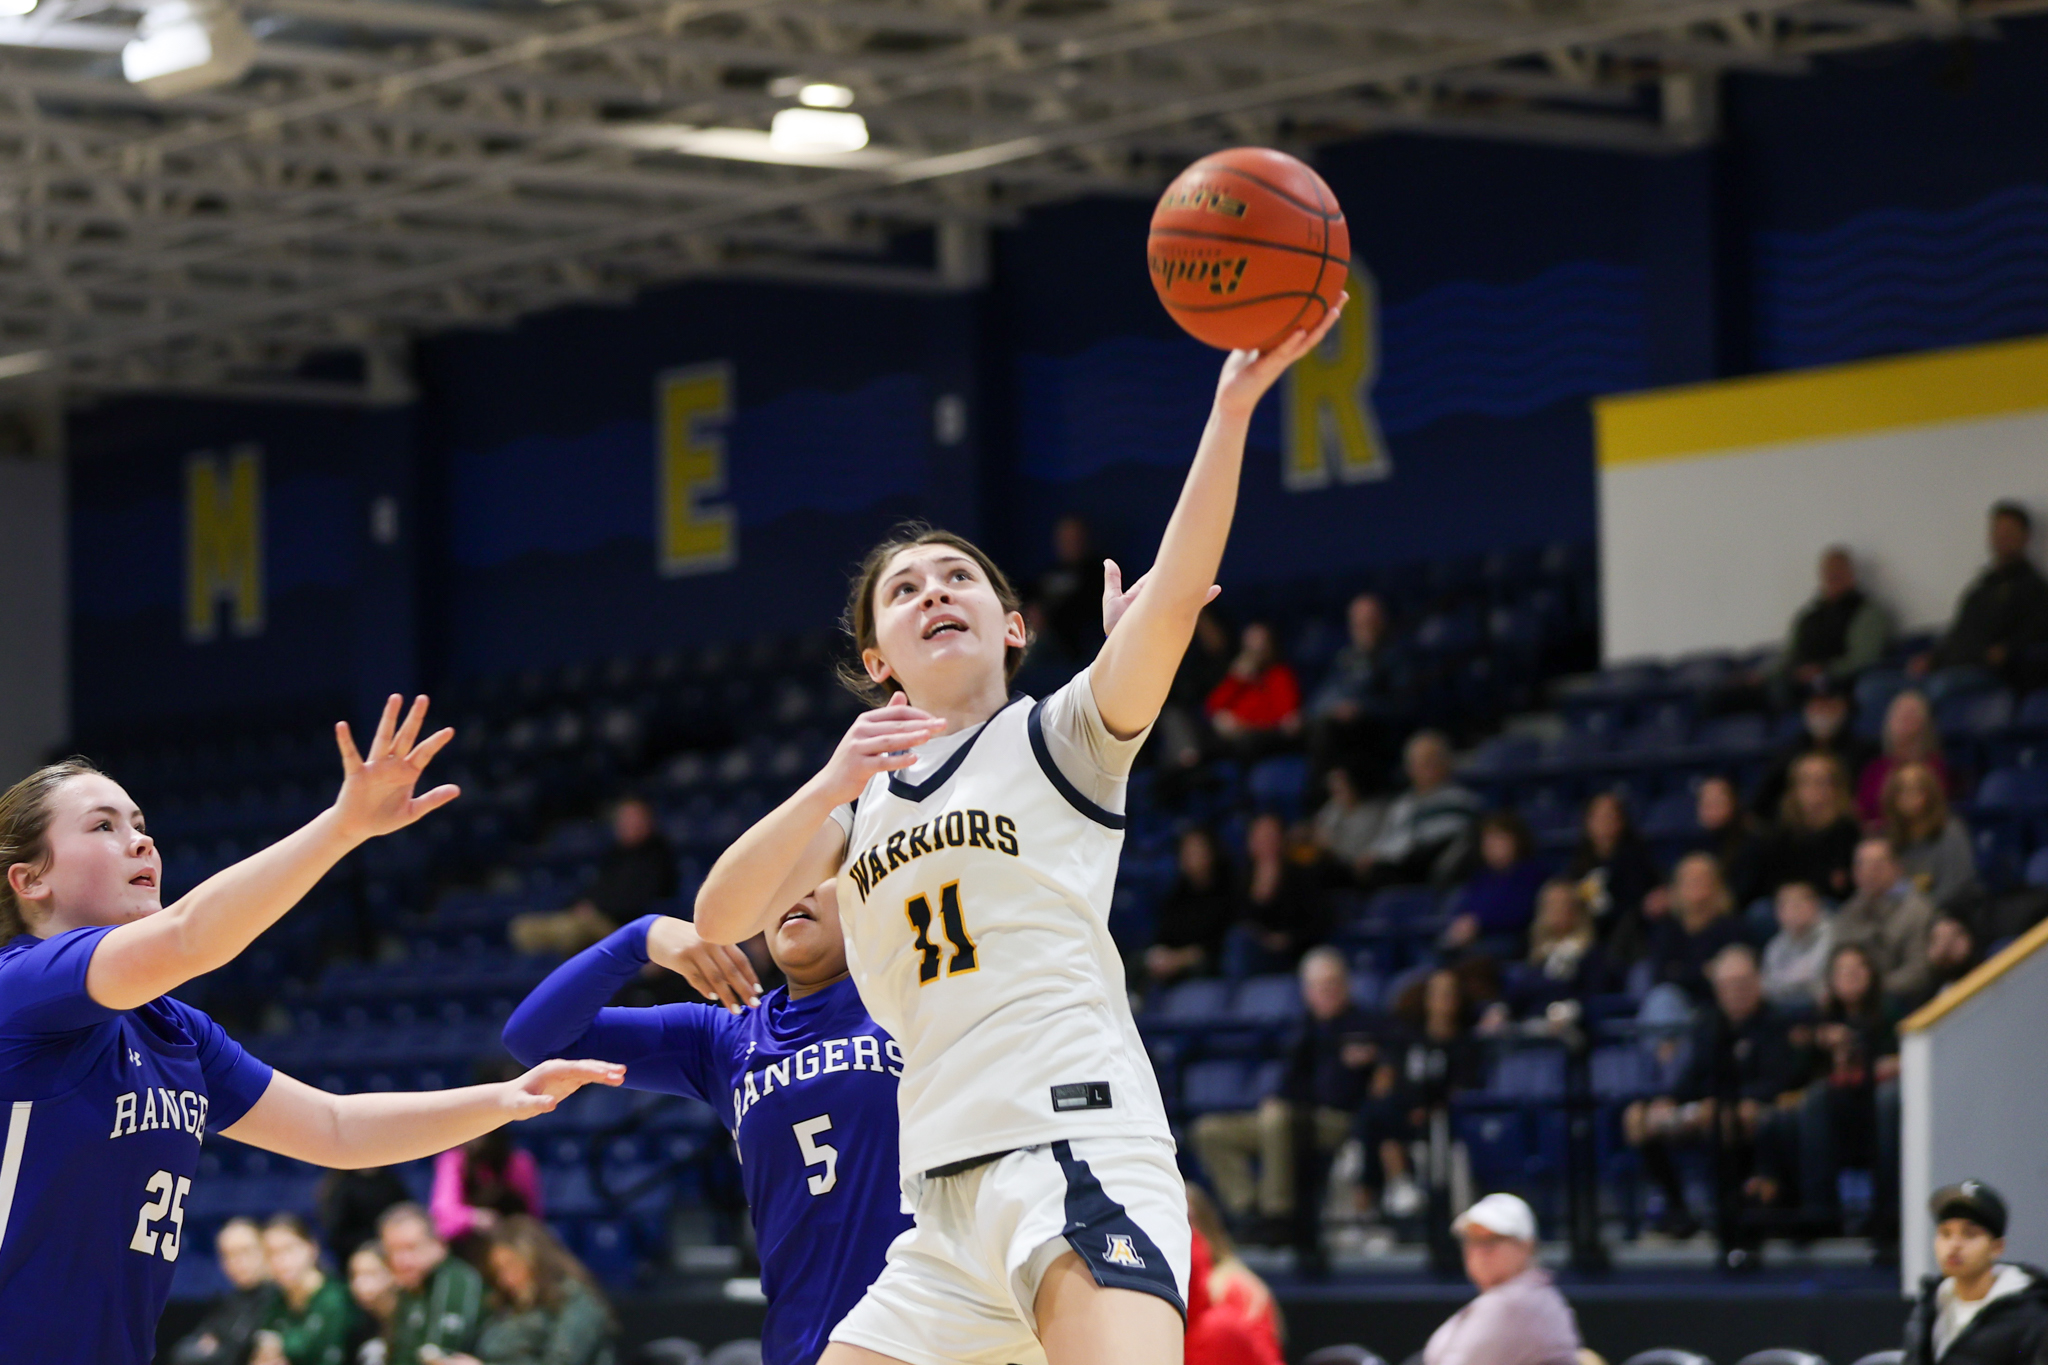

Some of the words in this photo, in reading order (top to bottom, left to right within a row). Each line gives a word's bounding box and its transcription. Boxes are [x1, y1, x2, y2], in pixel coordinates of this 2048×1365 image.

[187, 446, 262, 640] M
[658, 364, 735, 576] E
[849, 809, 1019, 905] WARRIORS
[904, 878, 980, 987] 11
[792, 1113, 838, 1196] 5
[129, 1169, 192, 1262] 25
